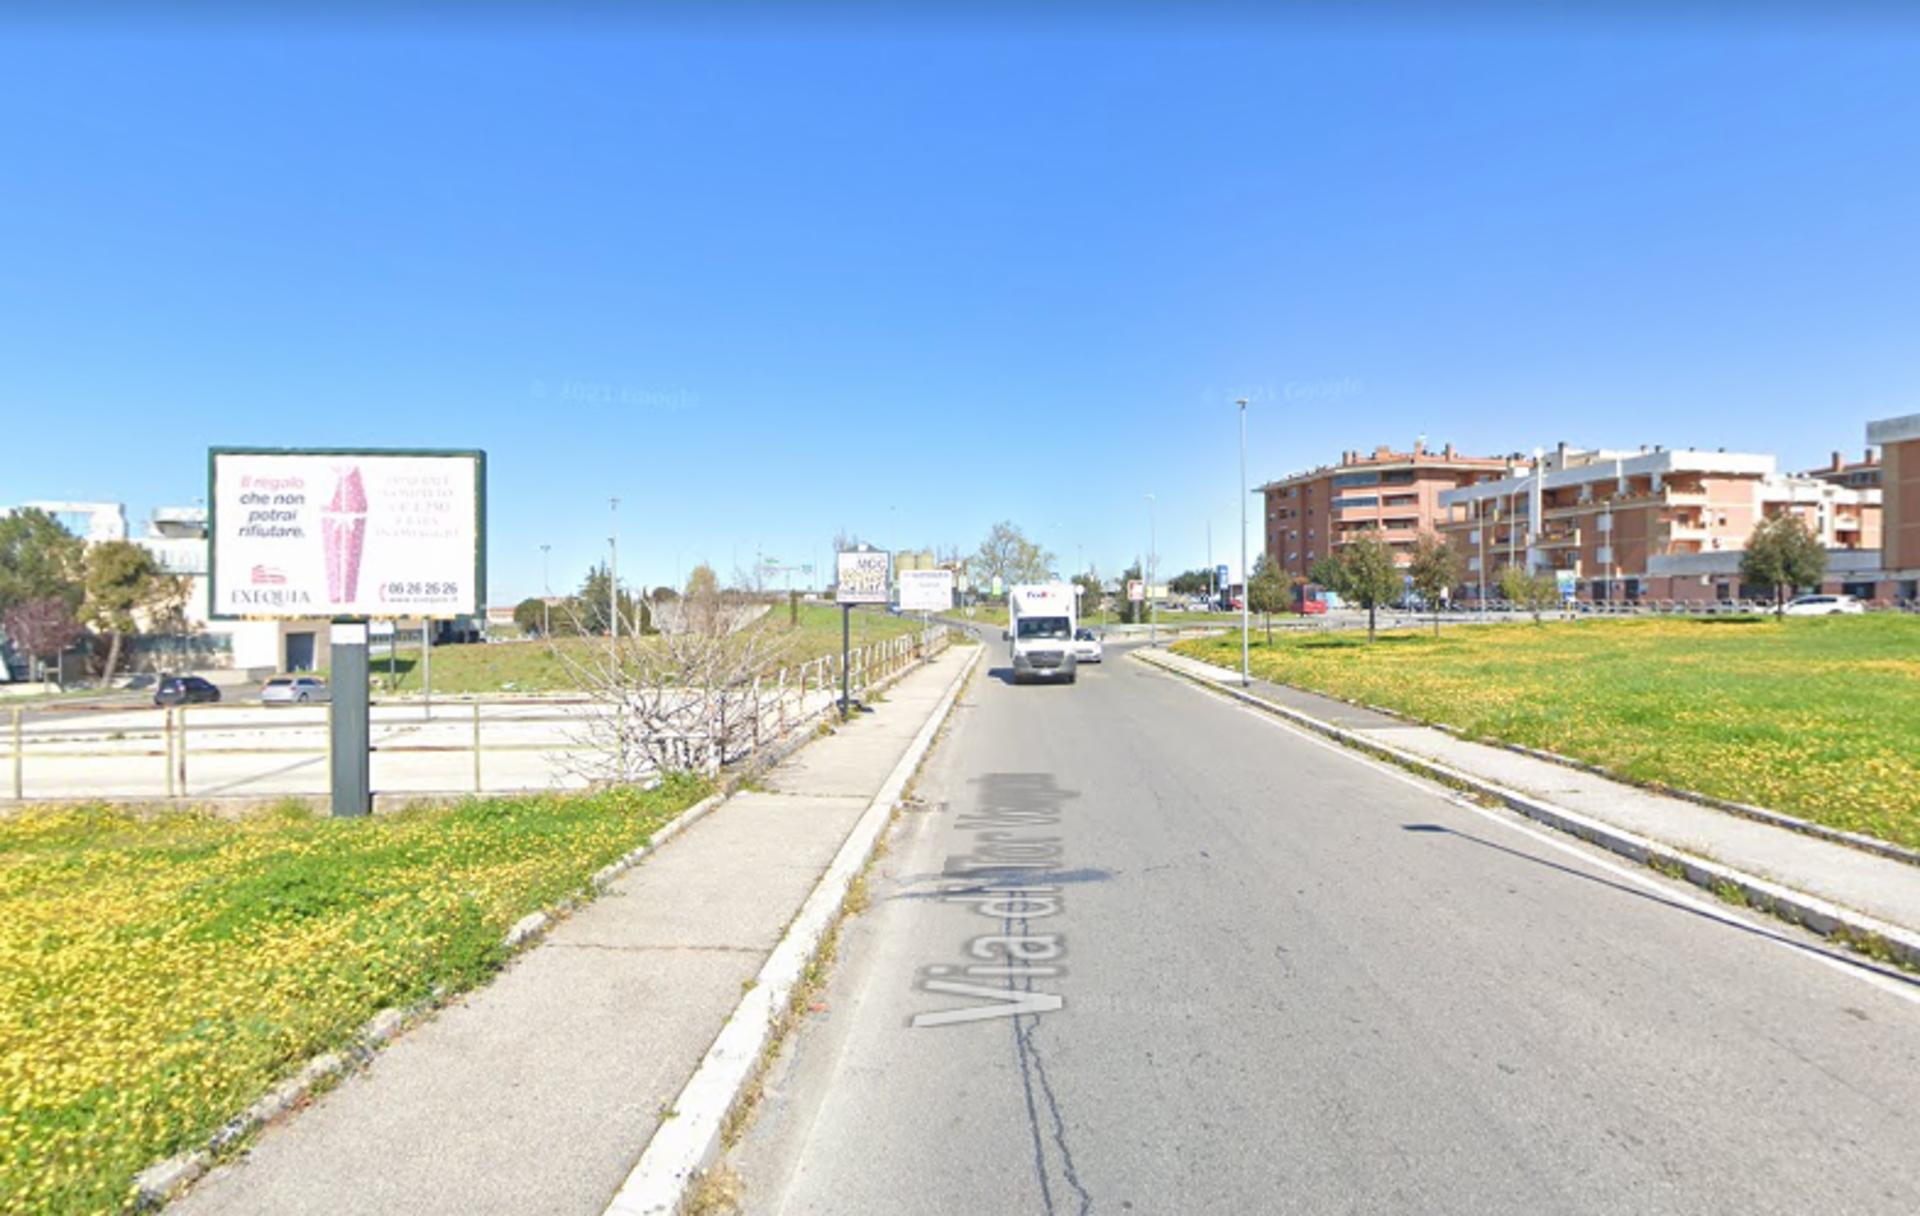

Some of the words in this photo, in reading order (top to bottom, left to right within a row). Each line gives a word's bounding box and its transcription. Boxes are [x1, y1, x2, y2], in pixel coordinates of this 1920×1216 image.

[239, 492, 270, 505] che
[273, 494, 306, 505] non
[248, 508, 298, 524] potrai
[239, 523, 306, 538] rifiutare.
[425, 582, 441, 595] 26
[442, 582, 458, 595] 26
[231, 589, 312, 607] EXEQUIA
